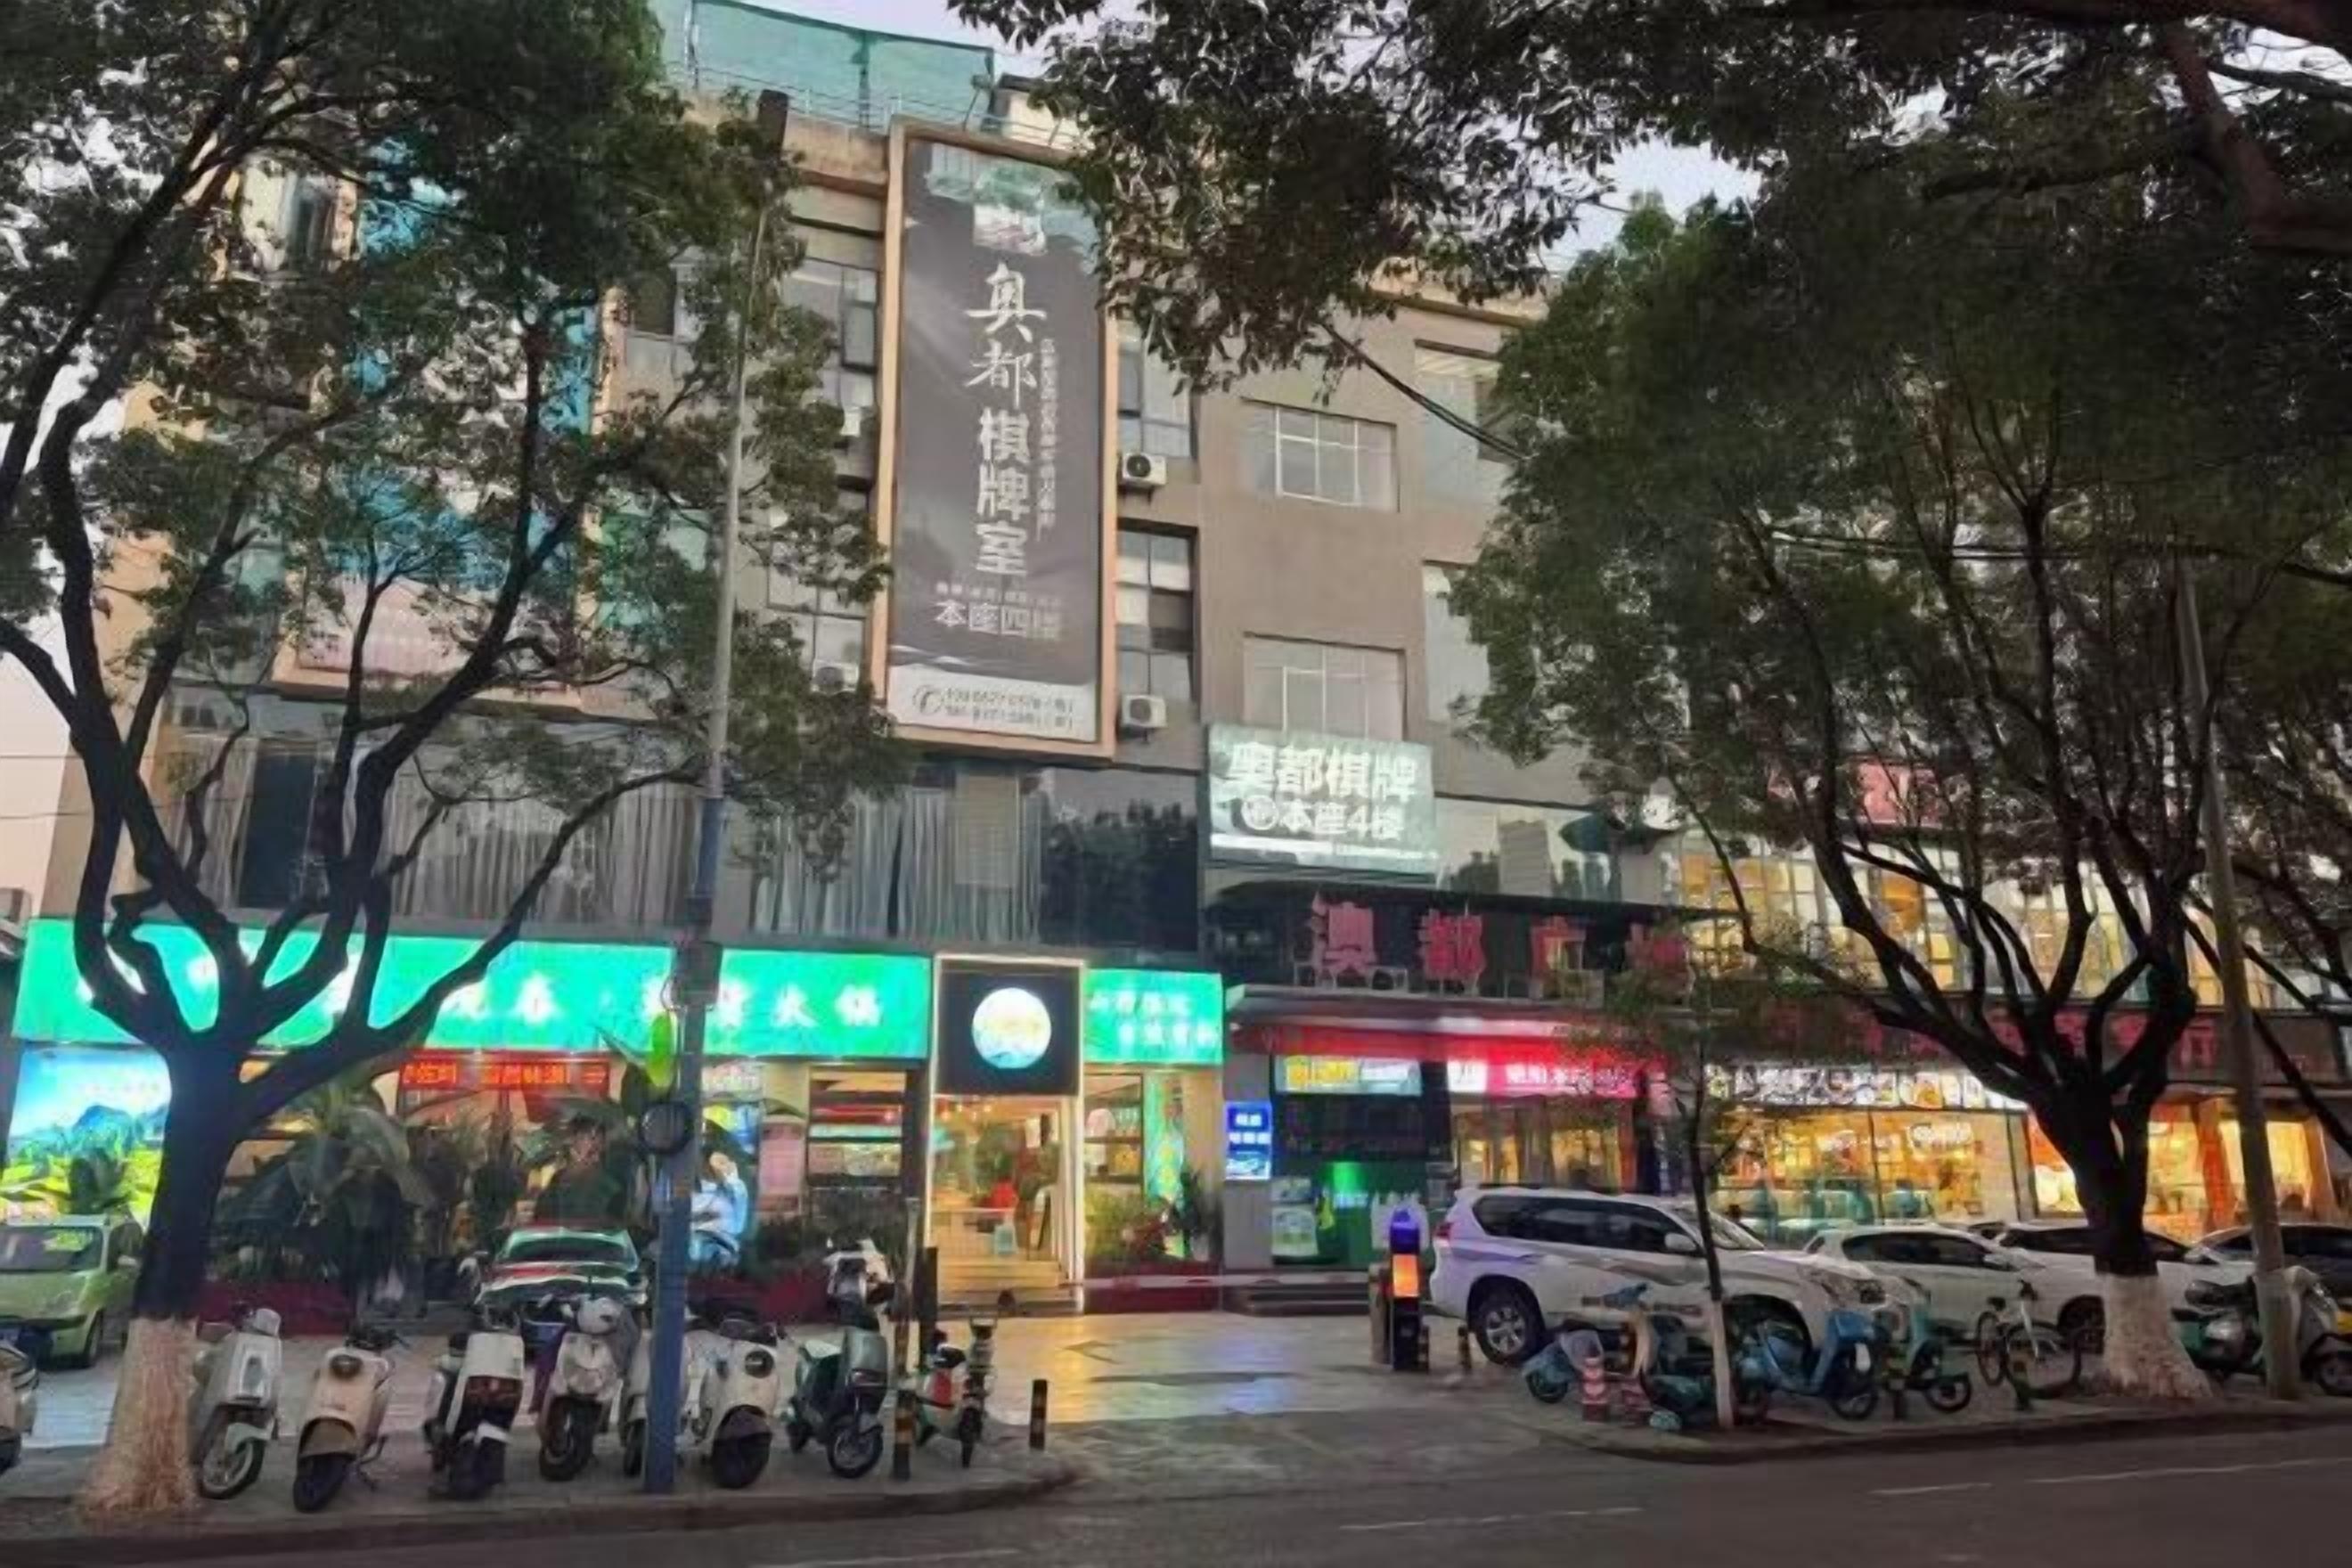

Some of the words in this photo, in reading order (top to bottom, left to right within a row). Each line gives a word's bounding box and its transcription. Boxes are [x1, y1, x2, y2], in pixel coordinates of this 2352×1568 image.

[964, 262, 1048, 577] 奥都棋牌室
